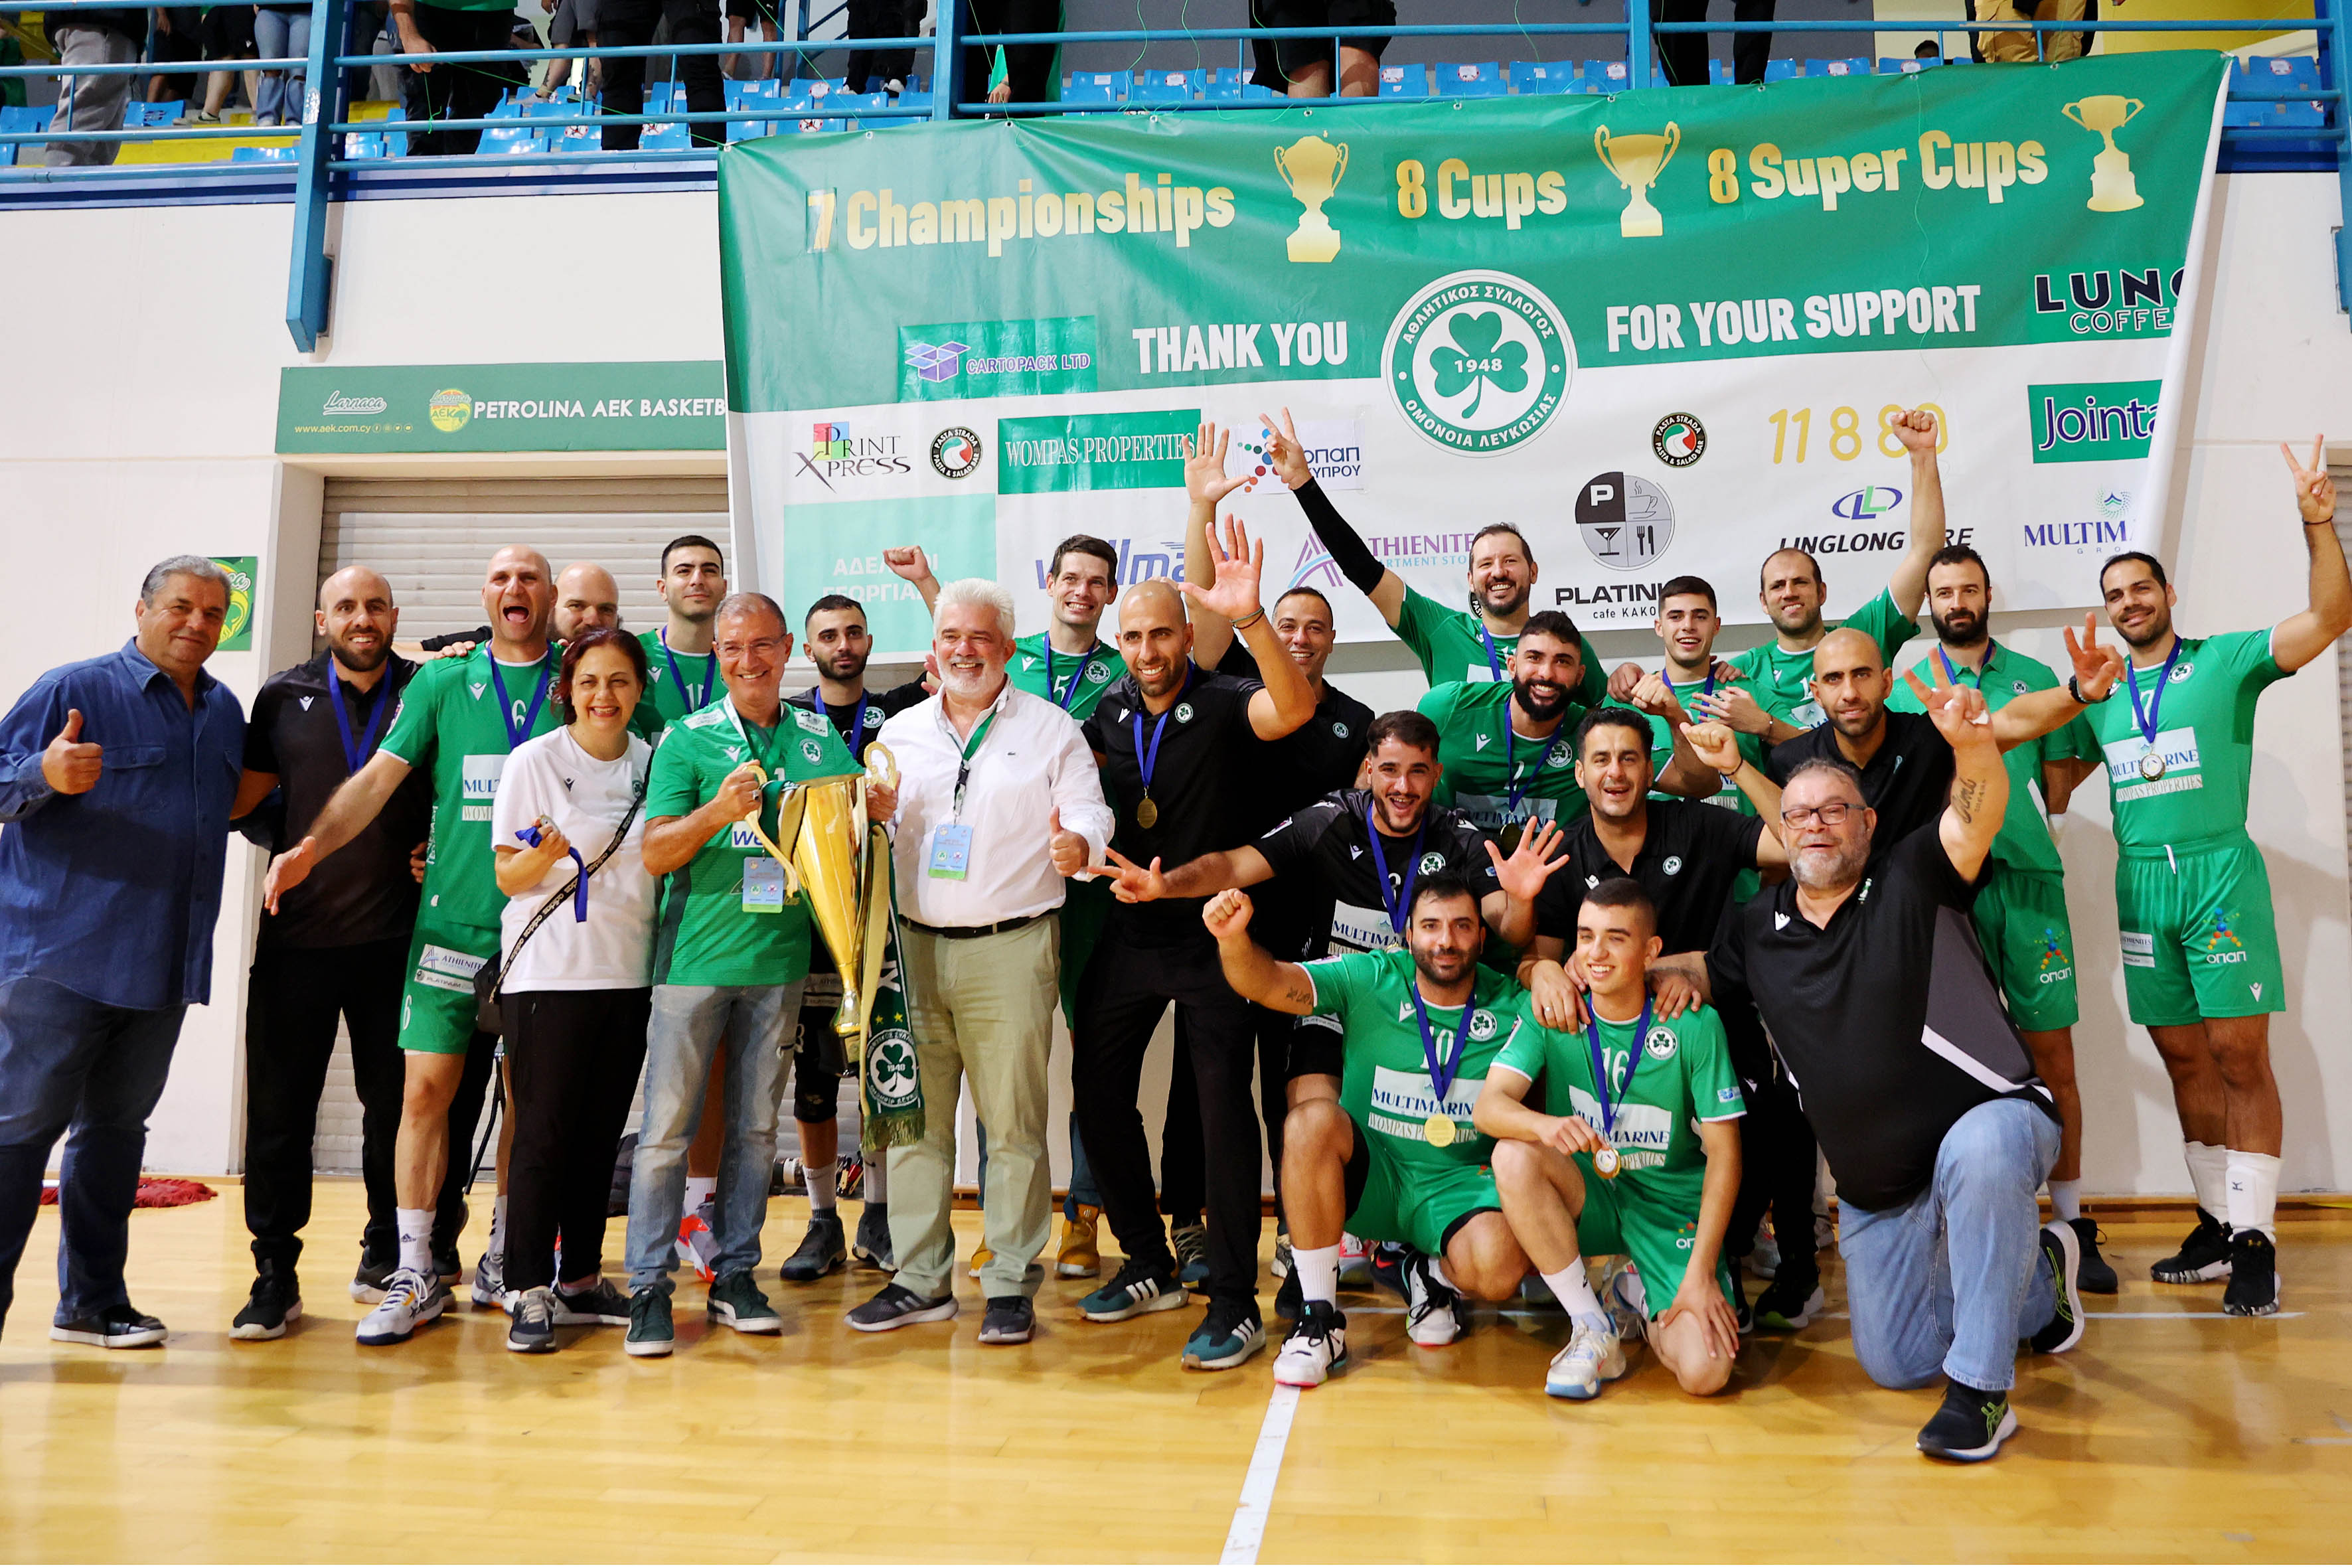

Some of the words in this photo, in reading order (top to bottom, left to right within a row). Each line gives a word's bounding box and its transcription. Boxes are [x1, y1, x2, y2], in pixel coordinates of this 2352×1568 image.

[1707, 148, 1739, 204] 8
[1748, 143, 1907, 212] Super
[1918, 130, 2049, 204] Cups
[1395, 159, 1428, 219] 8
[1437, 157, 1568, 230] Cups
[807, 192, 834, 252] 7
[846, 173, 1236, 258] Championships
[1402, 285, 1480, 345] ΑΘΛΗΤΙΚΟΣ
[1483, 285, 1555, 340] ΣΥΛΛΟΓΟΣ
[1606, 303, 1684, 354] FOR
[1688, 297, 1800, 349] YOUR
[1803, 284, 1982, 337] SUPPORT
[2069, 307, 2177, 334] COFFE
[1131, 322, 1263, 374] THANK
[1269, 321, 1348, 368] YOU
[965, 354, 1058, 375] CARTOPACK
[1060, 352, 1091, 370] LTD
[1454, 358, 1503, 374] 1948
[323, 390, 387, 415] Larnaca
[473, 400, 585, 420] PETROLINA
[591, 399, 633, 418] AEK
[295, 424, 372, 434] www.aek.com.cy
[1405, 399, 1474, 447] ΟΜΟΝΟΙΑ
[1479, 392, 1557, 447] ΛΕΥΚΩΣΙΑΣ
[1656, 417, 1675, 436] PASTA
[1676, 416, 1701, 434] STRADA
[823, 426, 901, 458] PRINT
[934, 430, 953, 449] PASTA
[955, 429, 978, 447] STRADA
[1005, 437, 1079, 467] WOMPAS
[933, 454, 946, 473] PASTA
[953, 465, 973, 477] SALAD
[971, 453, 980, 467] BAR
[1655, 441, 1669, 461] PASTA
[1676, 453, 1697, 466] SALAD
[1695, 440, 1704, 455] BAR
[1308, 465, 1361, 478] ΥΠΡΟΥ
[1590, 484, 1614, 507] P
[1368, 533, 1474, 557] THIENITE
[2024, 520, 2132, 546] MULTIM
[1442, 555, 1468, 565] STO
[1593, 609, 1616, 619] cafe
[1053, 674, 1070, 702] 5
[511, 699, 526, 730] 6
[2146, 775, 2203, 797] PROPERTIES
[403, 994, 412, 1030] 6
[1602, 1046, 1630, 1094] 16
[1372, 1088, 1474, 1116] MULTIMARIN
[1370, 1113, 1413, 1140] WOMPAS
